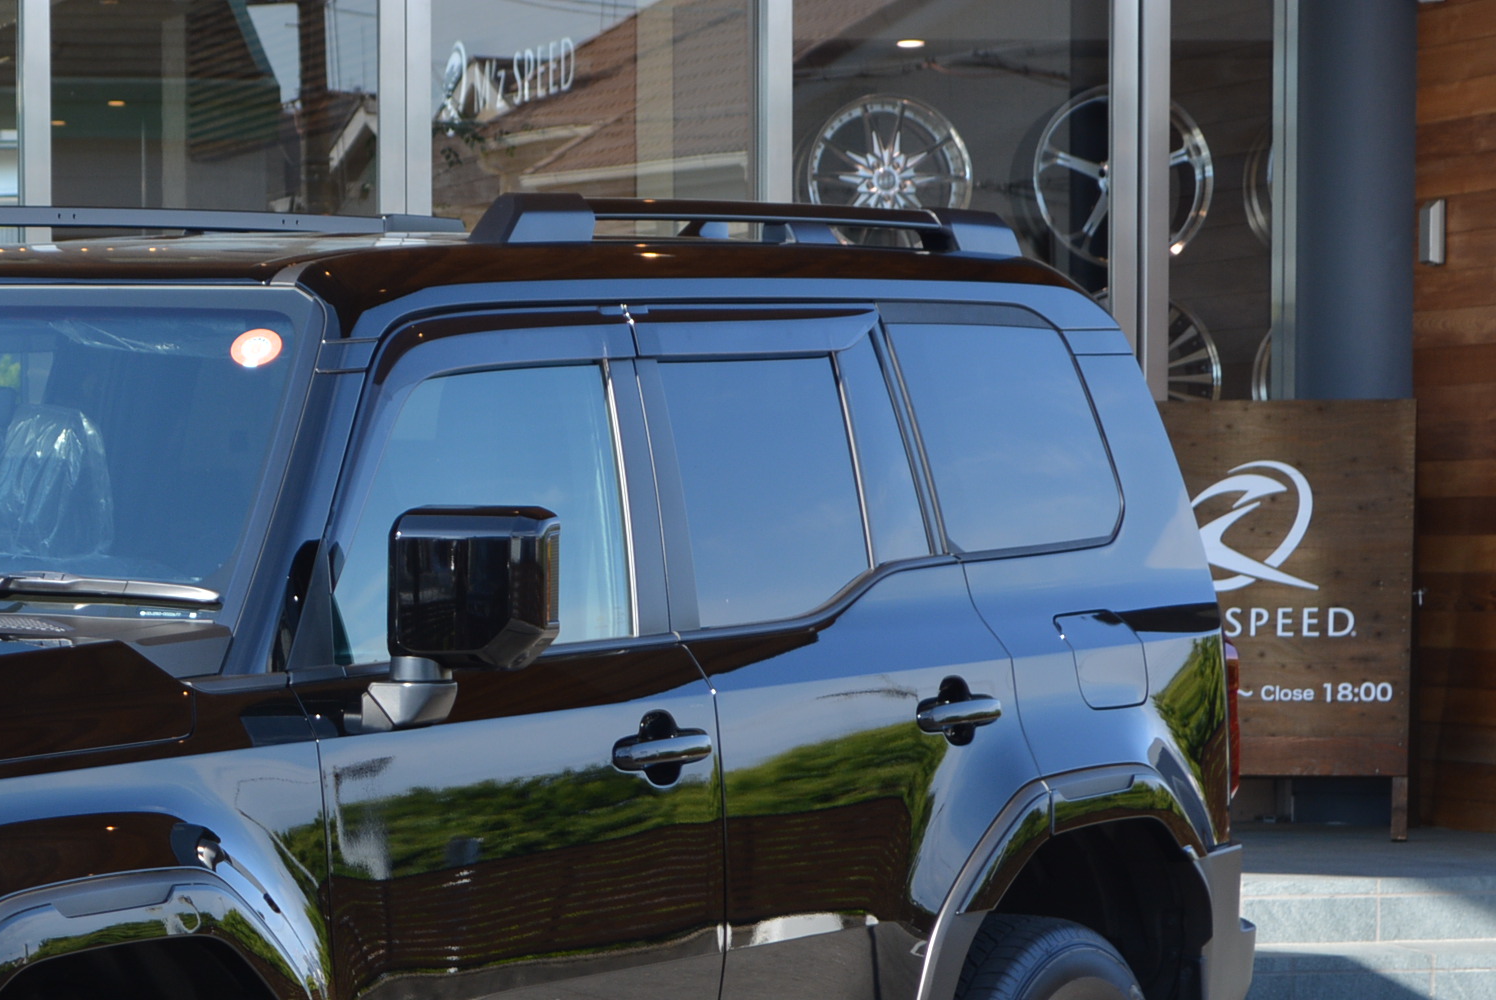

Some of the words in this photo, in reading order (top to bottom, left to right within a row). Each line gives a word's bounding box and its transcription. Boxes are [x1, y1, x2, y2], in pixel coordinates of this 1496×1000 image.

[473, 58, 508, 113] M'z
[513, 37, 576, 106] SPEED
[1225, 607, 1355, 638] SPEED
[1260, 685, 1315, 702] Close
[1323, 682, 1394, 703] 18:00
